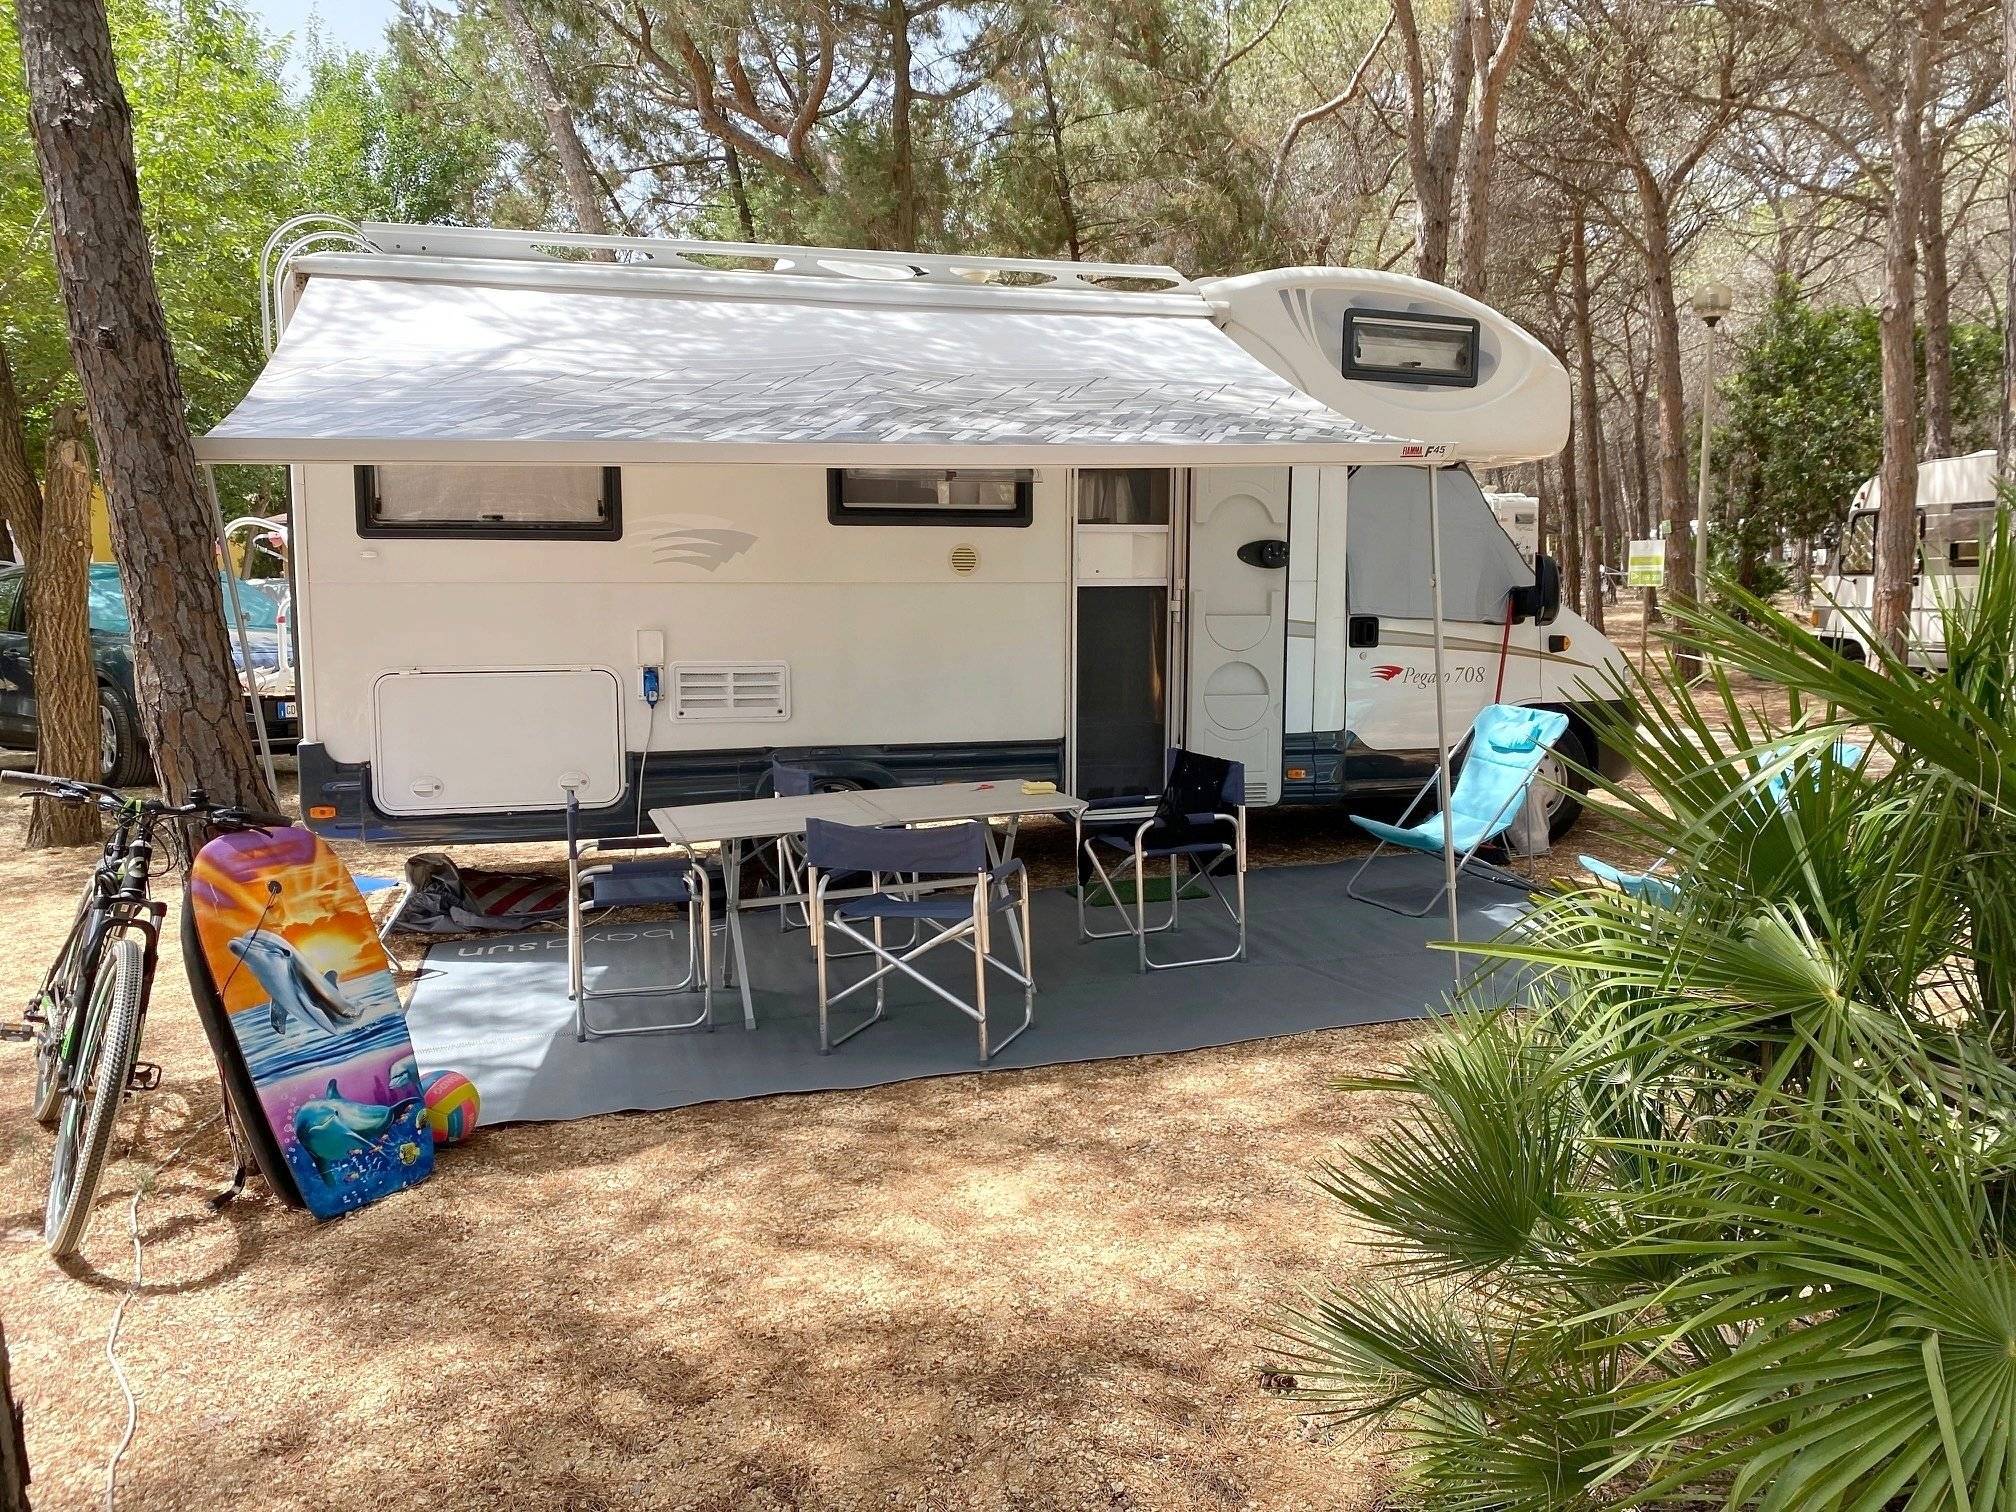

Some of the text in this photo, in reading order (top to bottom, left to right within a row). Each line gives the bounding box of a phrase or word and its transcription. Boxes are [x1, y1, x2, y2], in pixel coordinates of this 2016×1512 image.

[1402, 445, 1447, 457] FIAMMA F45
[1402, 666, 1486, 690] Pegao 708
